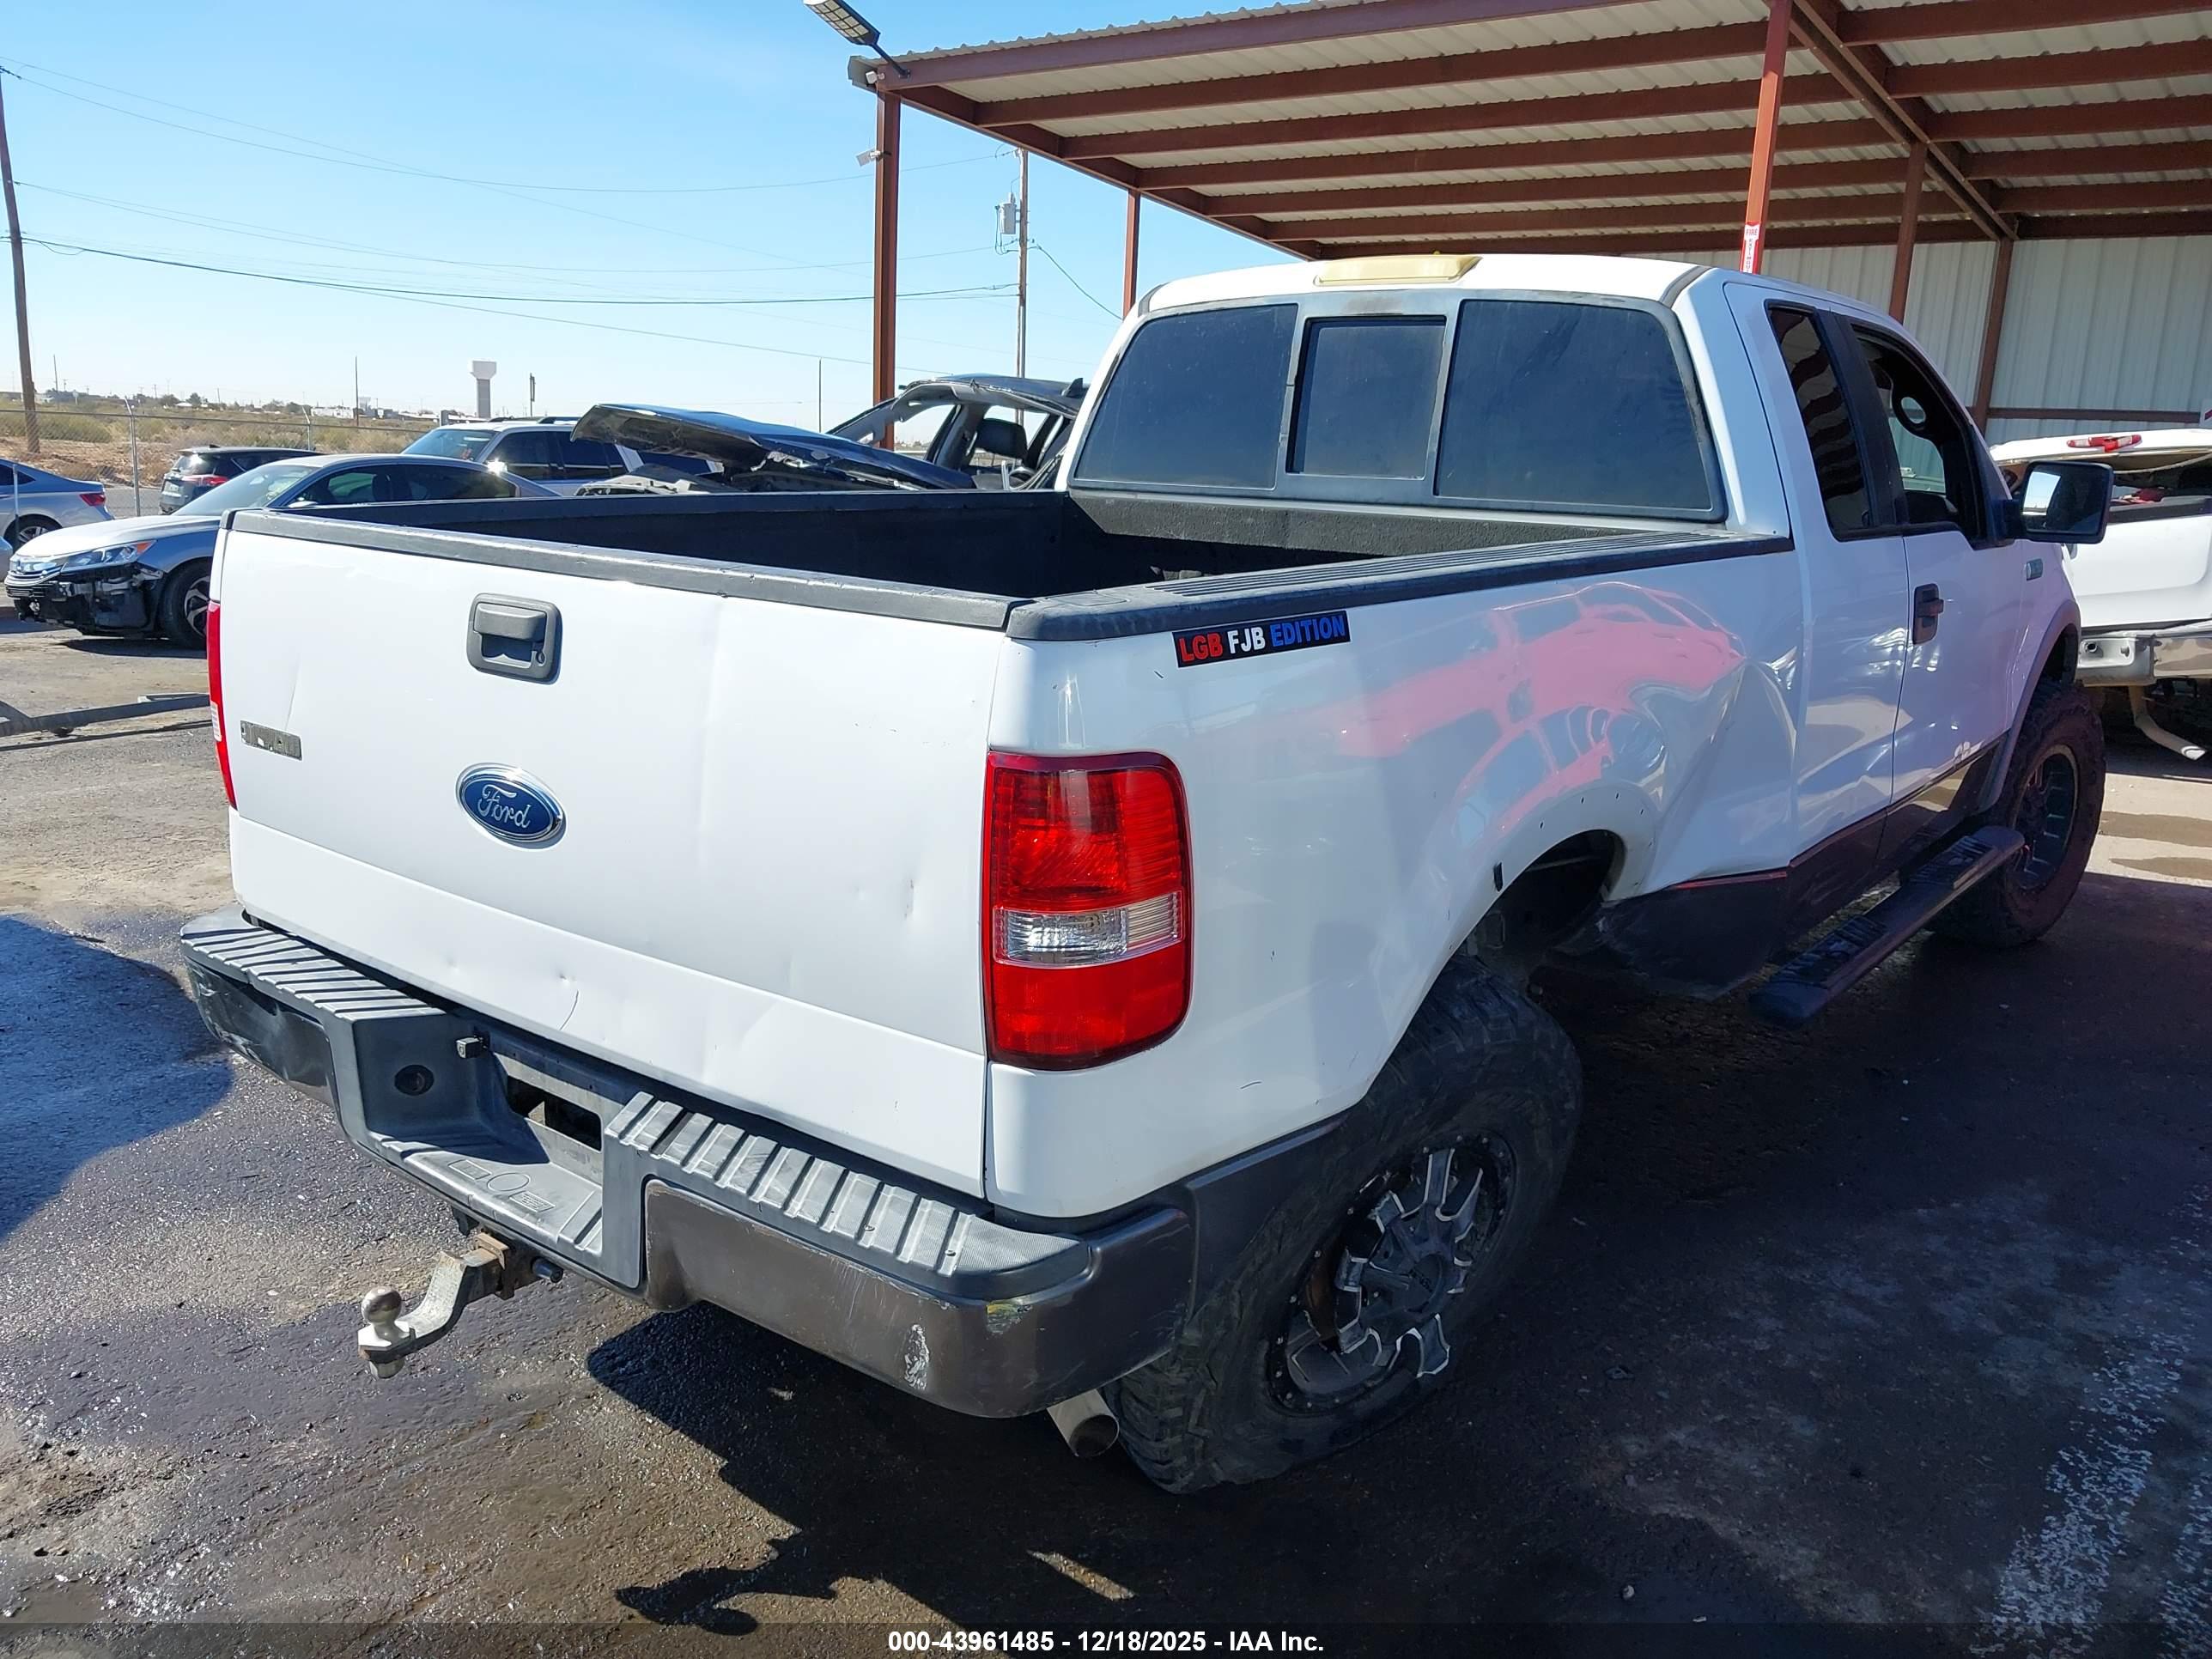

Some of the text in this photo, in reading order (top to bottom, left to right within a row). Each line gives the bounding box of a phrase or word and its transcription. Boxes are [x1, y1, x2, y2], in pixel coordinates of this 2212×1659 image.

[1179, 616, 1345, 661] LGB FJB EDITION
[478, 785, 532, 829] Ford
